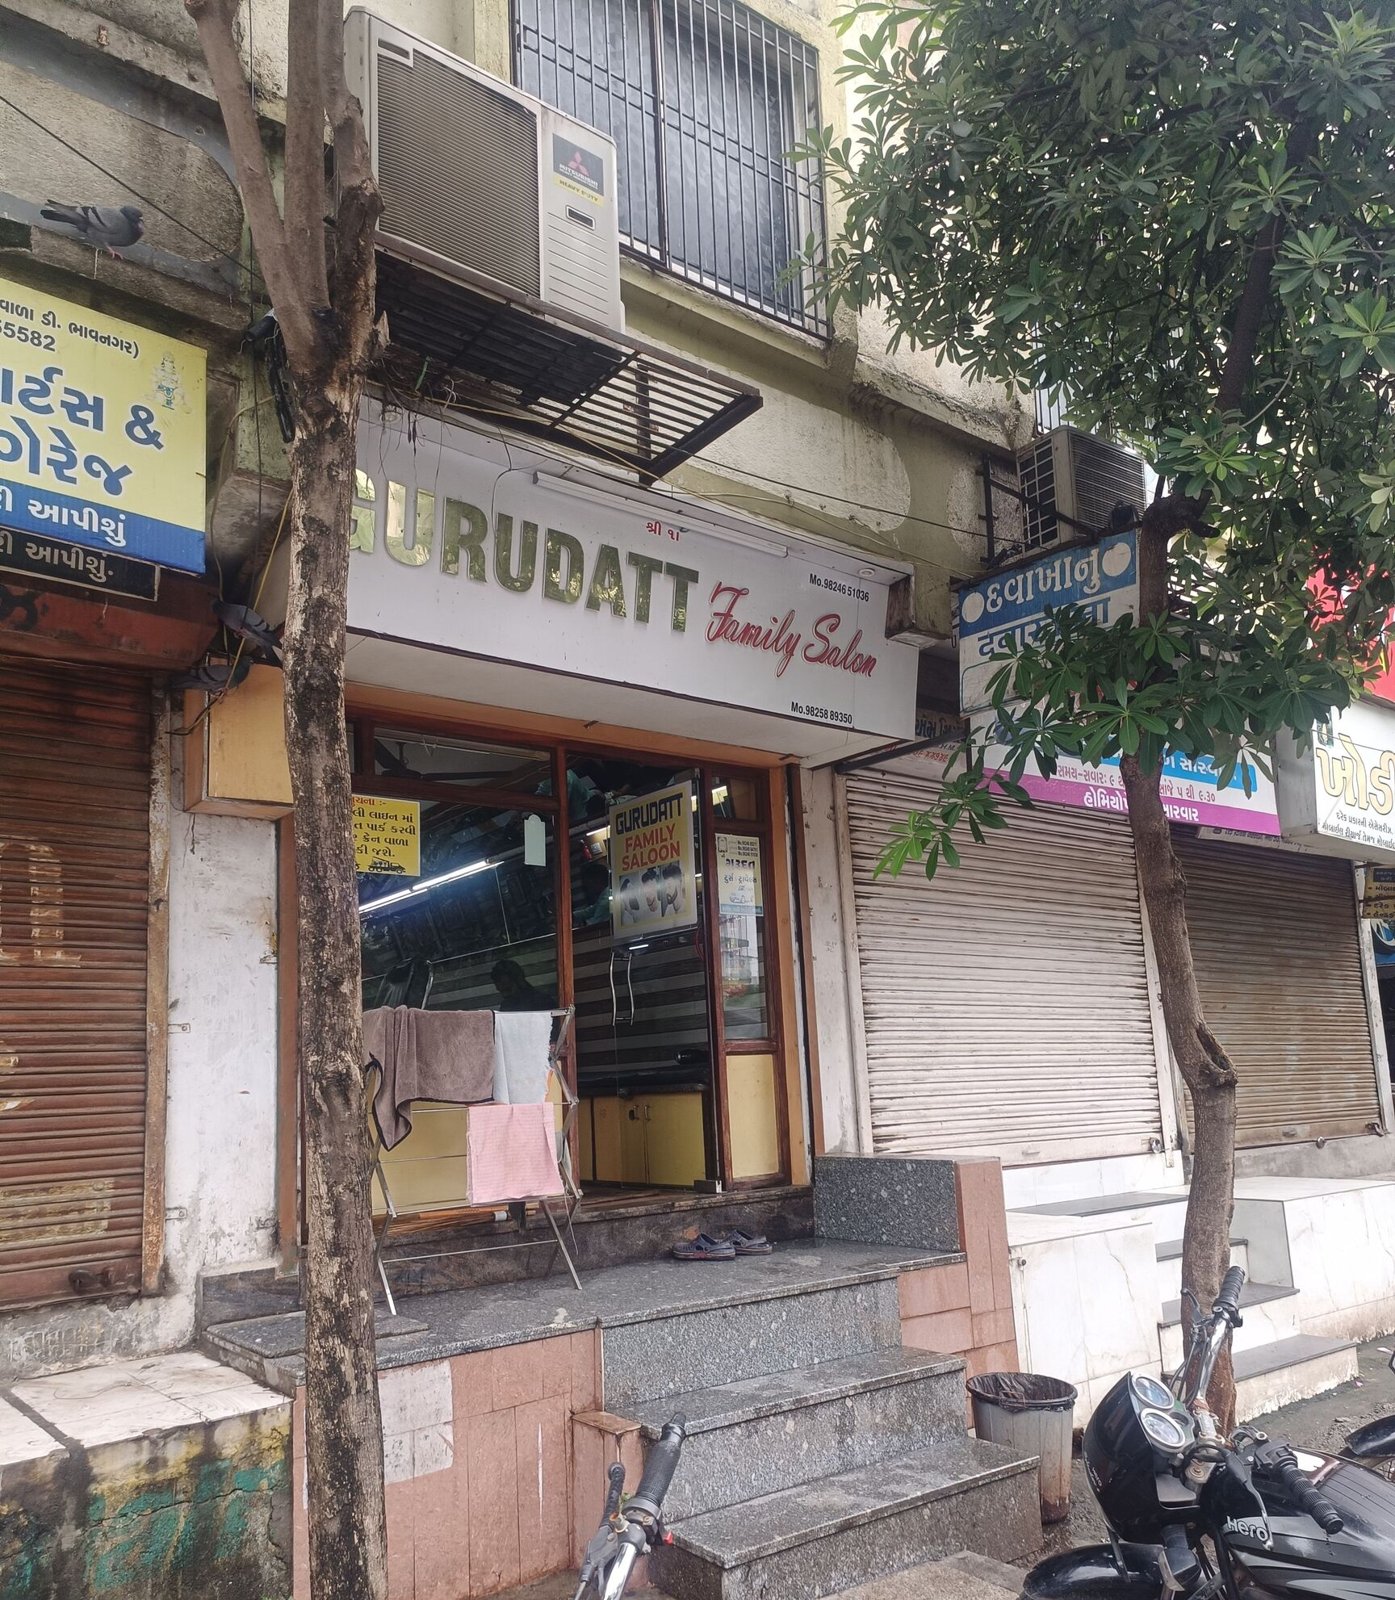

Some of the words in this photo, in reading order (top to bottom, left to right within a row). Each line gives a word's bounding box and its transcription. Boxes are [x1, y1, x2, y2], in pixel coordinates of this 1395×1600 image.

[0, 321, 56, 352] 5582
[68, 322, 139, 359] ભાવનગર)
[125, 404, 164, 450] &
[28, 499, 127, 547] આપીશું
[646, 521, 662, 536] શ્રી
[809, 573, 846, 595] Mo.98246
[847, 586, 870, 602] 51036
[706, 581, 802, 678] Family
[803, 613, 878, 678] Salon
[791, 701, 829, 720] Mo.98258
[829, 710, 853, 724] 89350
[615, 792, 683, 835] GURUDATT
[625, 823, 676, 854] FAMILY
[622, 840, 681, 872] SALOON
[1227, 1515, 1268, 1542] Hero
